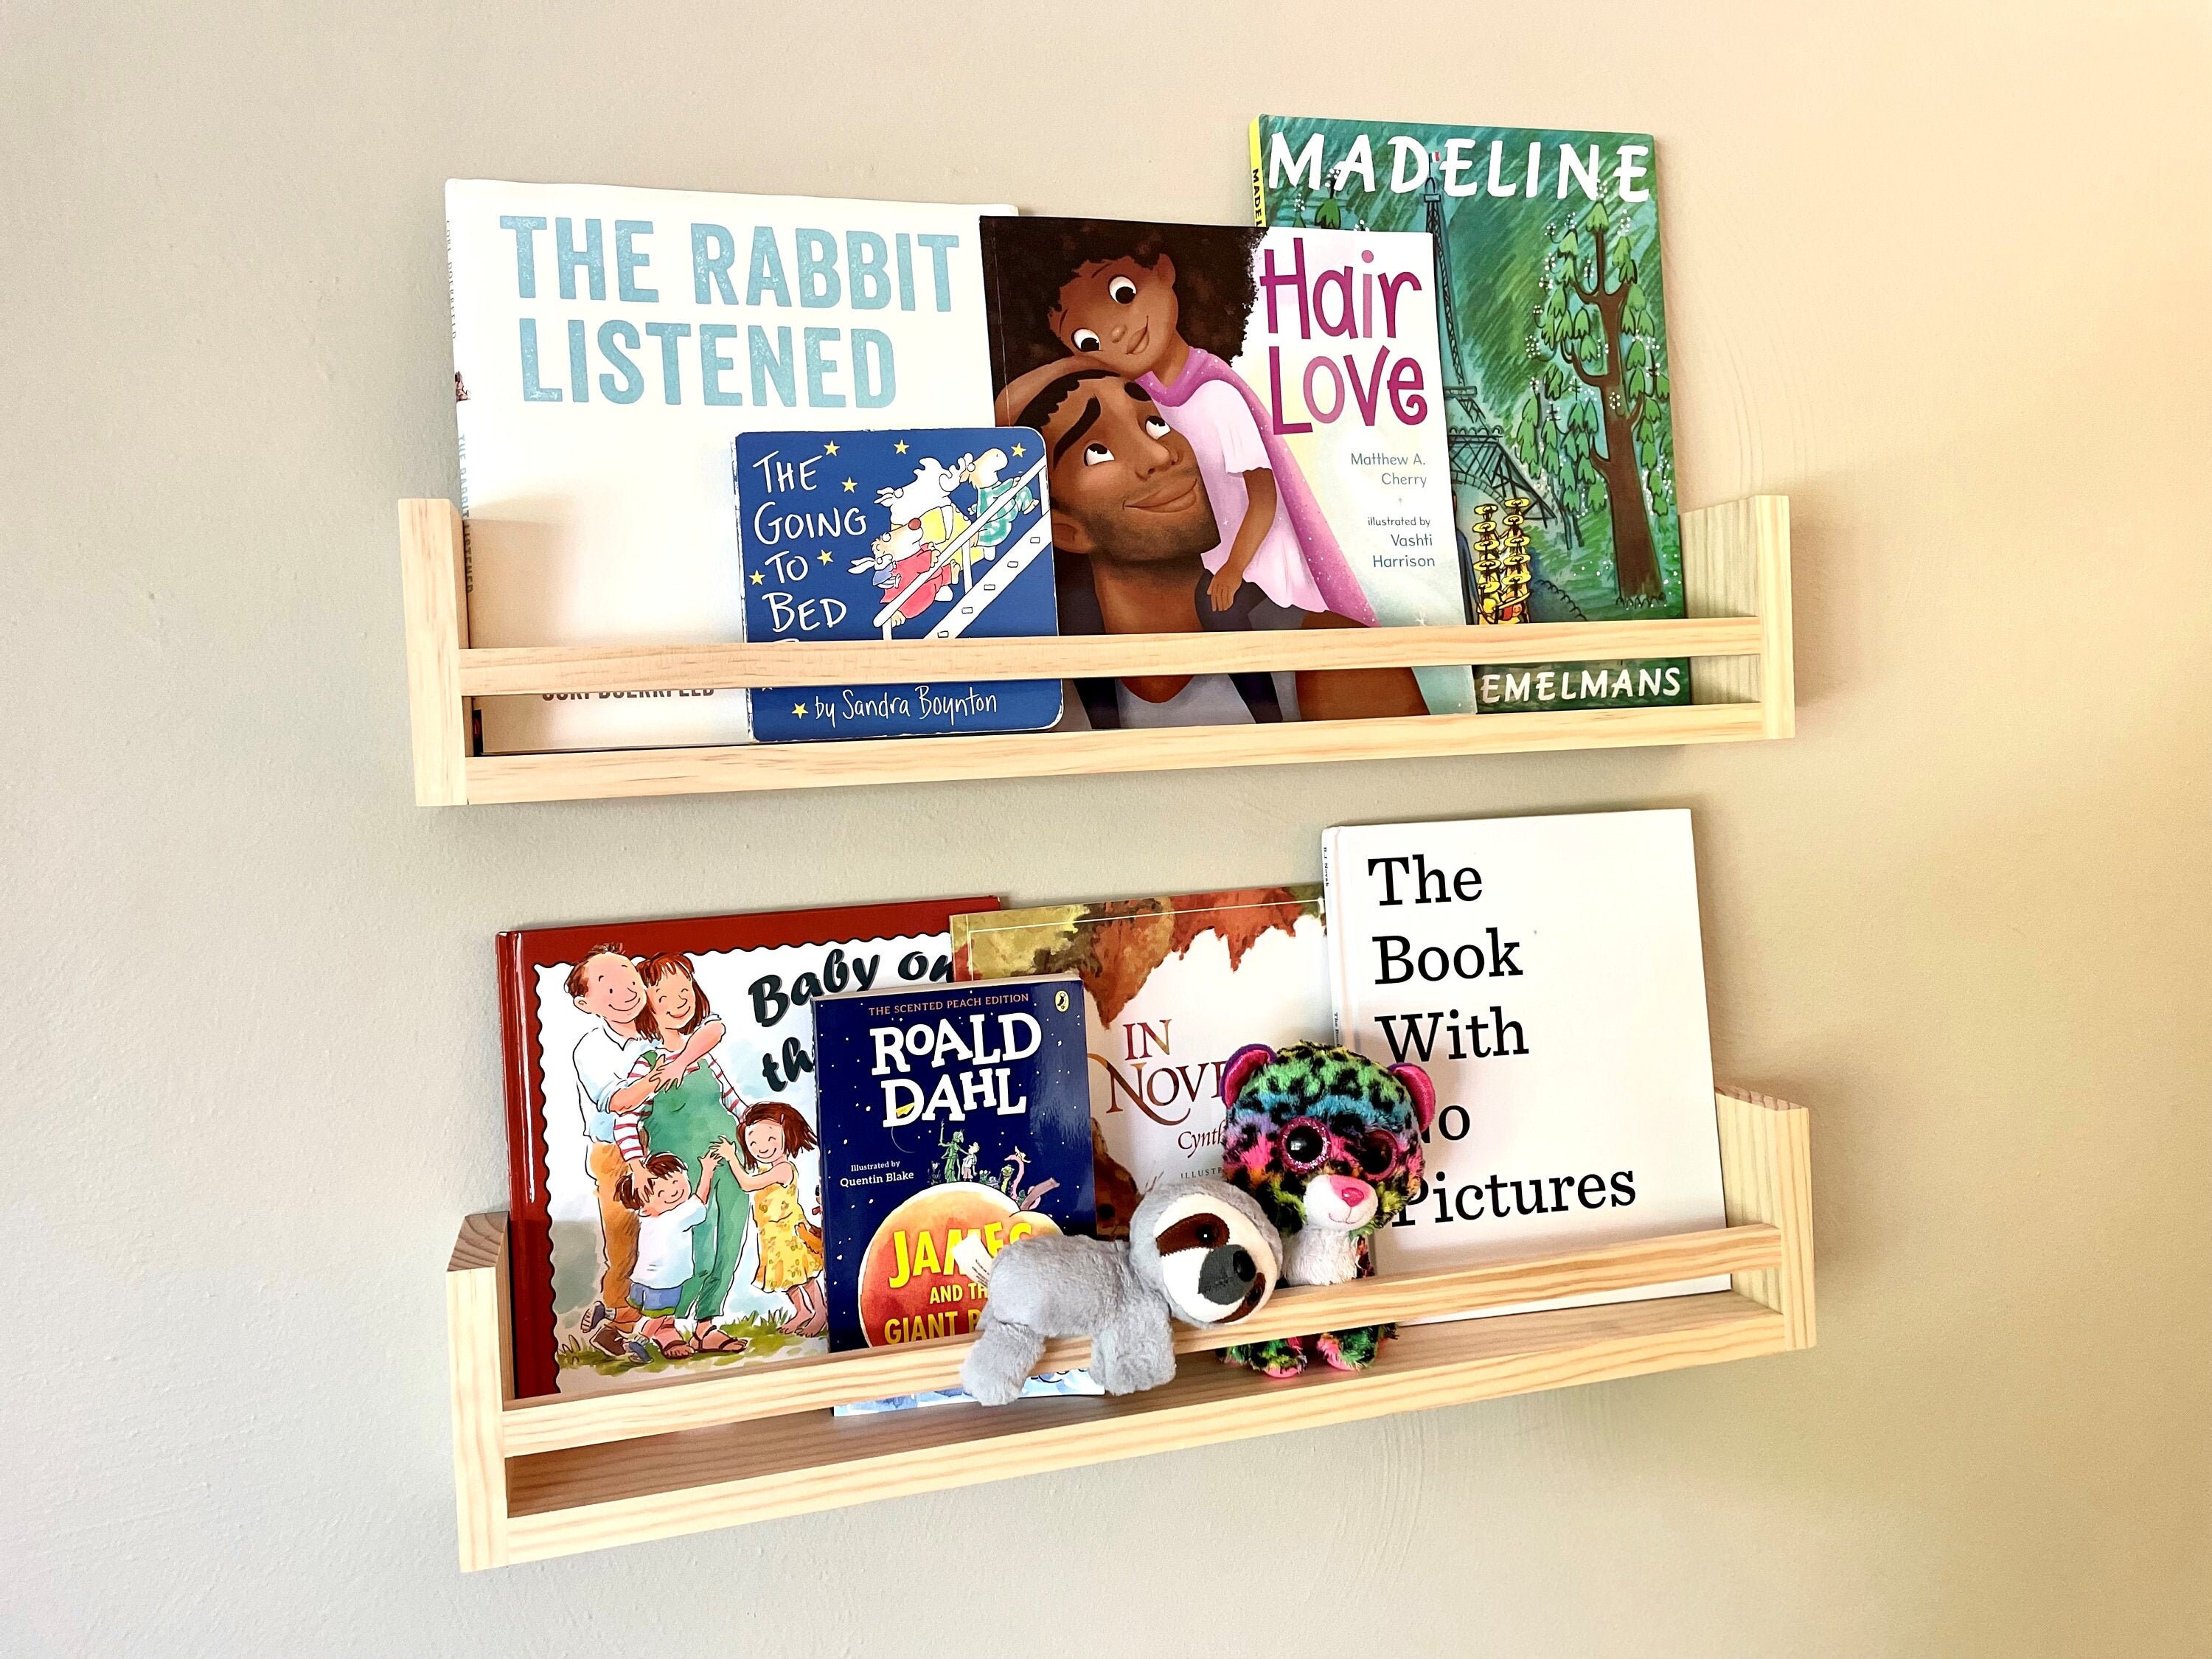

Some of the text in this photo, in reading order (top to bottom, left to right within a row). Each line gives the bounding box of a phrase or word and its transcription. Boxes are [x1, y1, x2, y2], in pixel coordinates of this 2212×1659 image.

[1269, 132, 1649, 203] MADELINE
[499, 215, 660, 304] THE
[691, 223, 959, 312] RABBIT
[1259, 237, 1422, 340] Hair
[519, 318, 896, 408] LISTENED
[752, 451, 823, 493] THE
[1351, 453, 1426, 465] Matthew A.
[1381, 473, 1427, 488] Cherry
[754, 501, 866, 546] GOING
[1368, 517, 1430, 527] illustrated by
[1391, 534, 1433, 546] Vashti
[765, 550, 808, 584] TO
[1373, 555, 1435, 568] Harrison
[762, 592, 847, 633] BED
[815, 685, 997, 728] by Sandra Boynton
[1368, 854, 1482, 906] The
[1372, 927, 1523, 984] Book
[748, 948, 880, 1027] Baby
[869, 993, 1029, 1016] THE SCENTED PEACH EDITION
[869, 1012, 1043, 1076] ROALD
[1122, 1019, 1172, 1060] IN
[1374, 1006, 1529, 1062] With
[880, 1067, 1027, 1128] DAHL
[840, 1171, 914, 1188] Quentin Blake
[851, 1161, 889, 1172] Illustrated
[1391, 1169, 1636, 1228] Pictures
[929, 1283, 963, 1304] AND
[885, 1311, 959, 1345] GIANT
